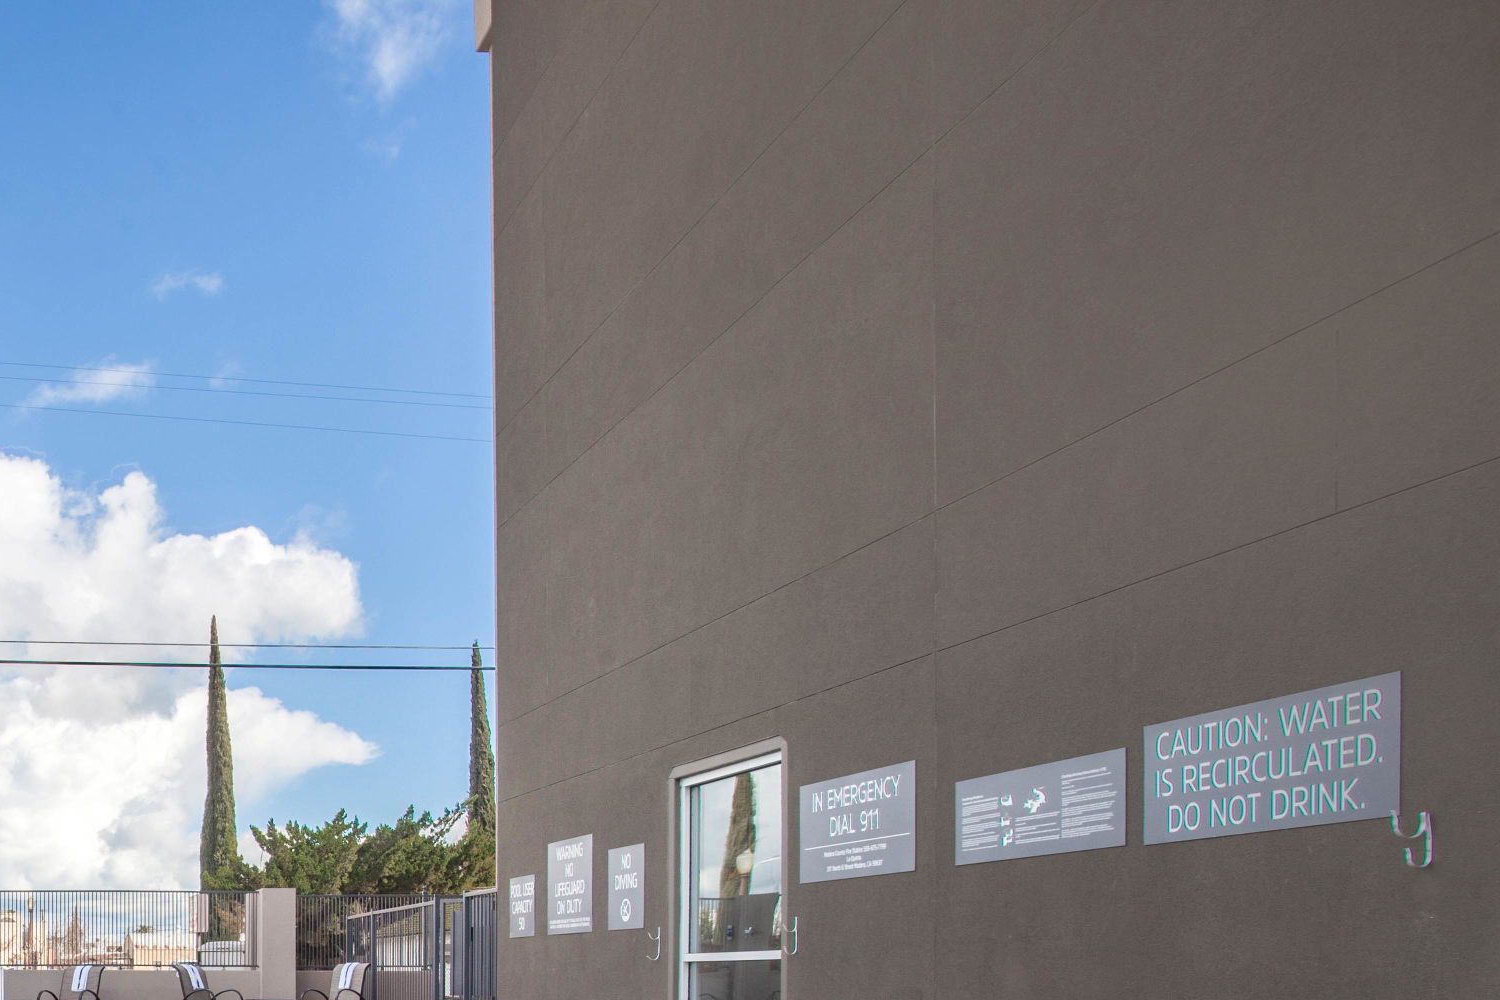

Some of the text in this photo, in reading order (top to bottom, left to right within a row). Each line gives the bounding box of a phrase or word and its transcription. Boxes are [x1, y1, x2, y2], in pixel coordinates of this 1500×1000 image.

[1156, 688, 1383, 760] CAUTION: WATER
[1155, 733, 1384, 798] IS RECIRCULATED.
[812, 774, 901, 813] IN EMERGENCY
[1167, 778, 1366, 833] DO NOT DRINK.
[829, 807, 880, 837] DIAL 911
[555, 842, 584, 861] WARNING
[564, 862, 574, 877] NO
[620, 853, 632, 870] NO
[510, 881, 535, 898] POOL USER
[554, 879, 585, 897] LIFEGUARD
[614, 872, 638, 891] DIVING
[512, 899, 533, 915] CAPACITY
[557, 898, 582, 915] ON DUTY
